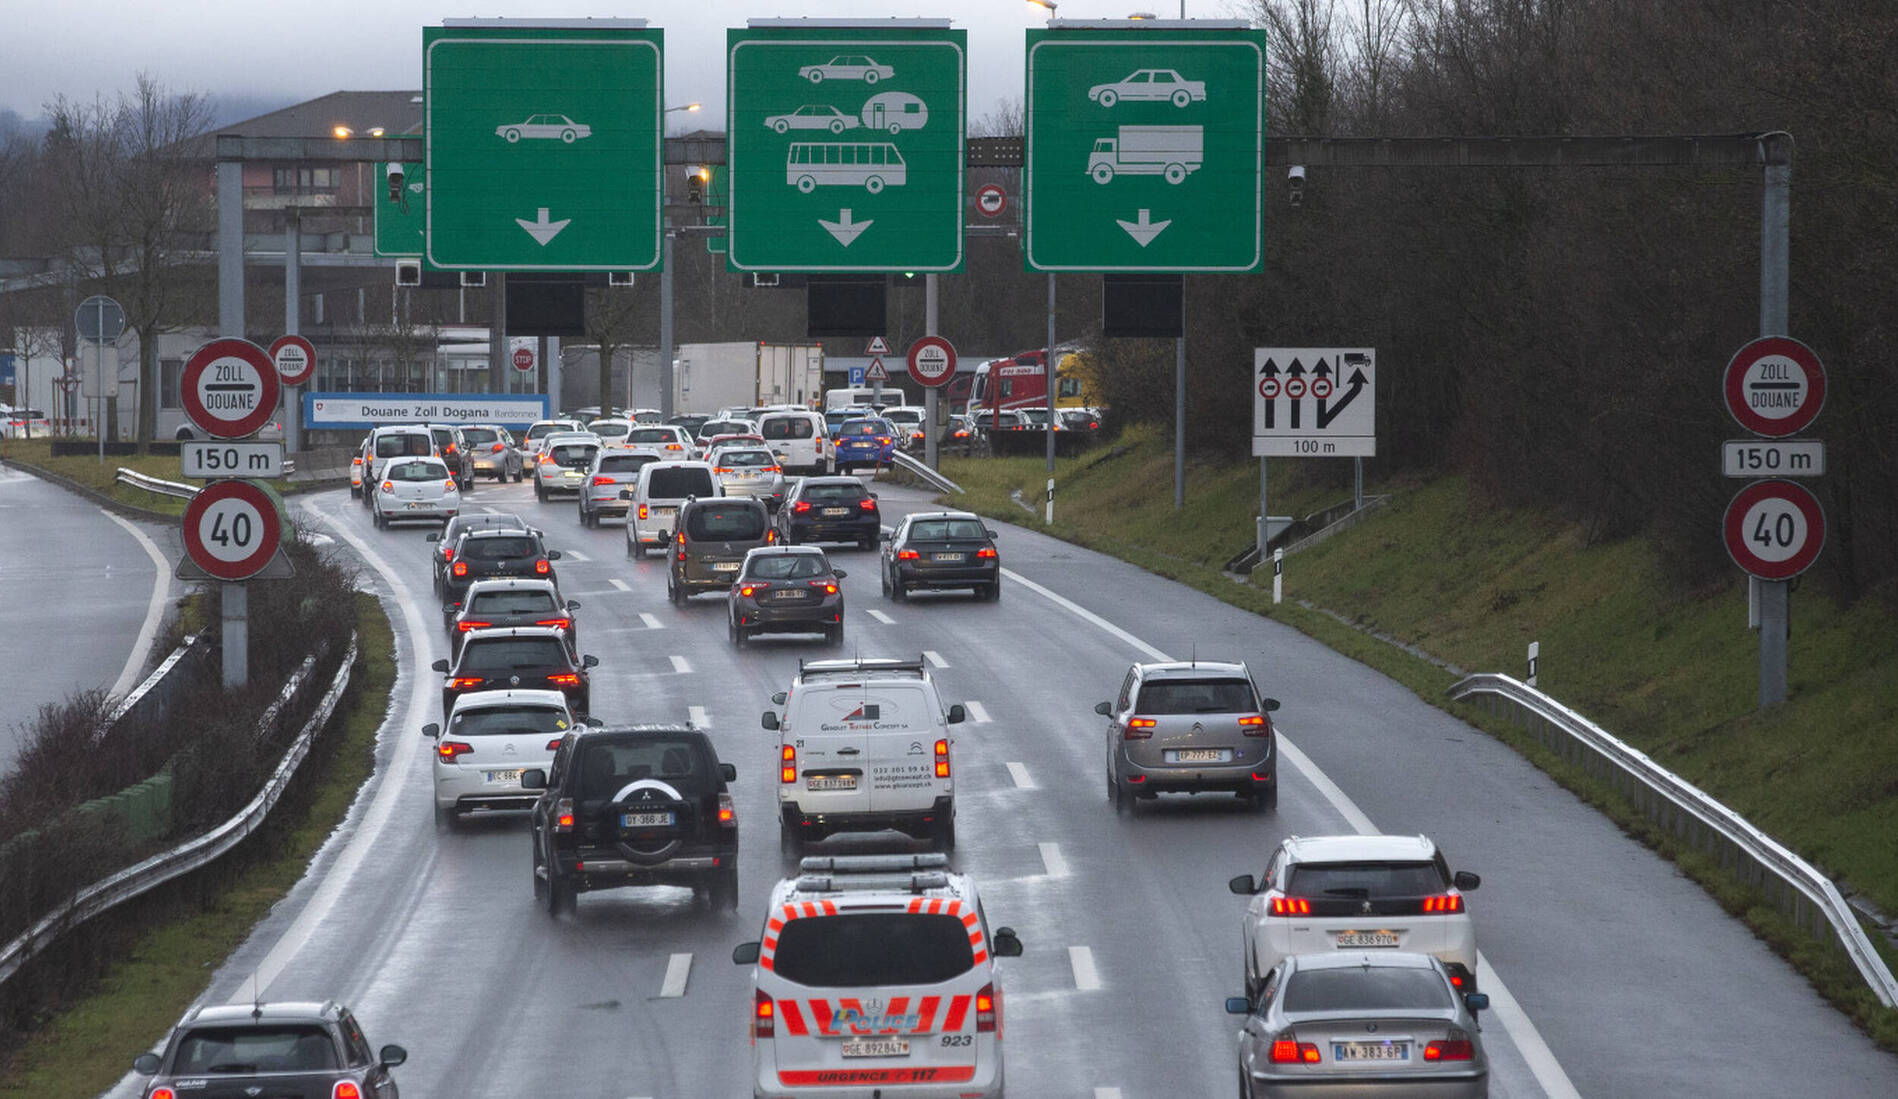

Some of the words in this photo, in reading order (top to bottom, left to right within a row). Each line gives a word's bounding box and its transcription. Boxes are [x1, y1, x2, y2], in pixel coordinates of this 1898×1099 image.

[515, 355, 532, 364] STOP
[924, 349, 939, 358] ZOLL
[215, 365, 245, 382] ZOLL
[920, 363, 944, 372] DOUANE
[1760, 364, 1790, 380] ZOLL
[206, 393, 254, 410] DOUANE
[1751, 391, 1800, 408] DOUANE
[361, 405, 409, 418] Douane
[414, 405, 438, 418] Zoll
[443, 406, 490, 420] Dogana
[1294, 440, 1319, 453] 100
[1323, 443, 1336, 453] m
[196, 448, 239, 470] 150
[248, 453, 270, 469] m
[1737, 448, 1780, 470] 150
[1790, 452, 1811, 469] m
[210, 513, 252, 547] 40
[1753, 512, 1796, 548] 40
[1344, 935, 1356, 945] GE
[1358, 935, 1393, 945] 836970
[829, 1008, 921, 1031] POLICE
[850, 1043, 861, 1055] GE
[865, 1042, 902, 1054] 892847
[941, 1035, 973, 1048] 923
[817, 1070, 890, 1083] URGENCE
[911, 1068, 938, 1081] 117
